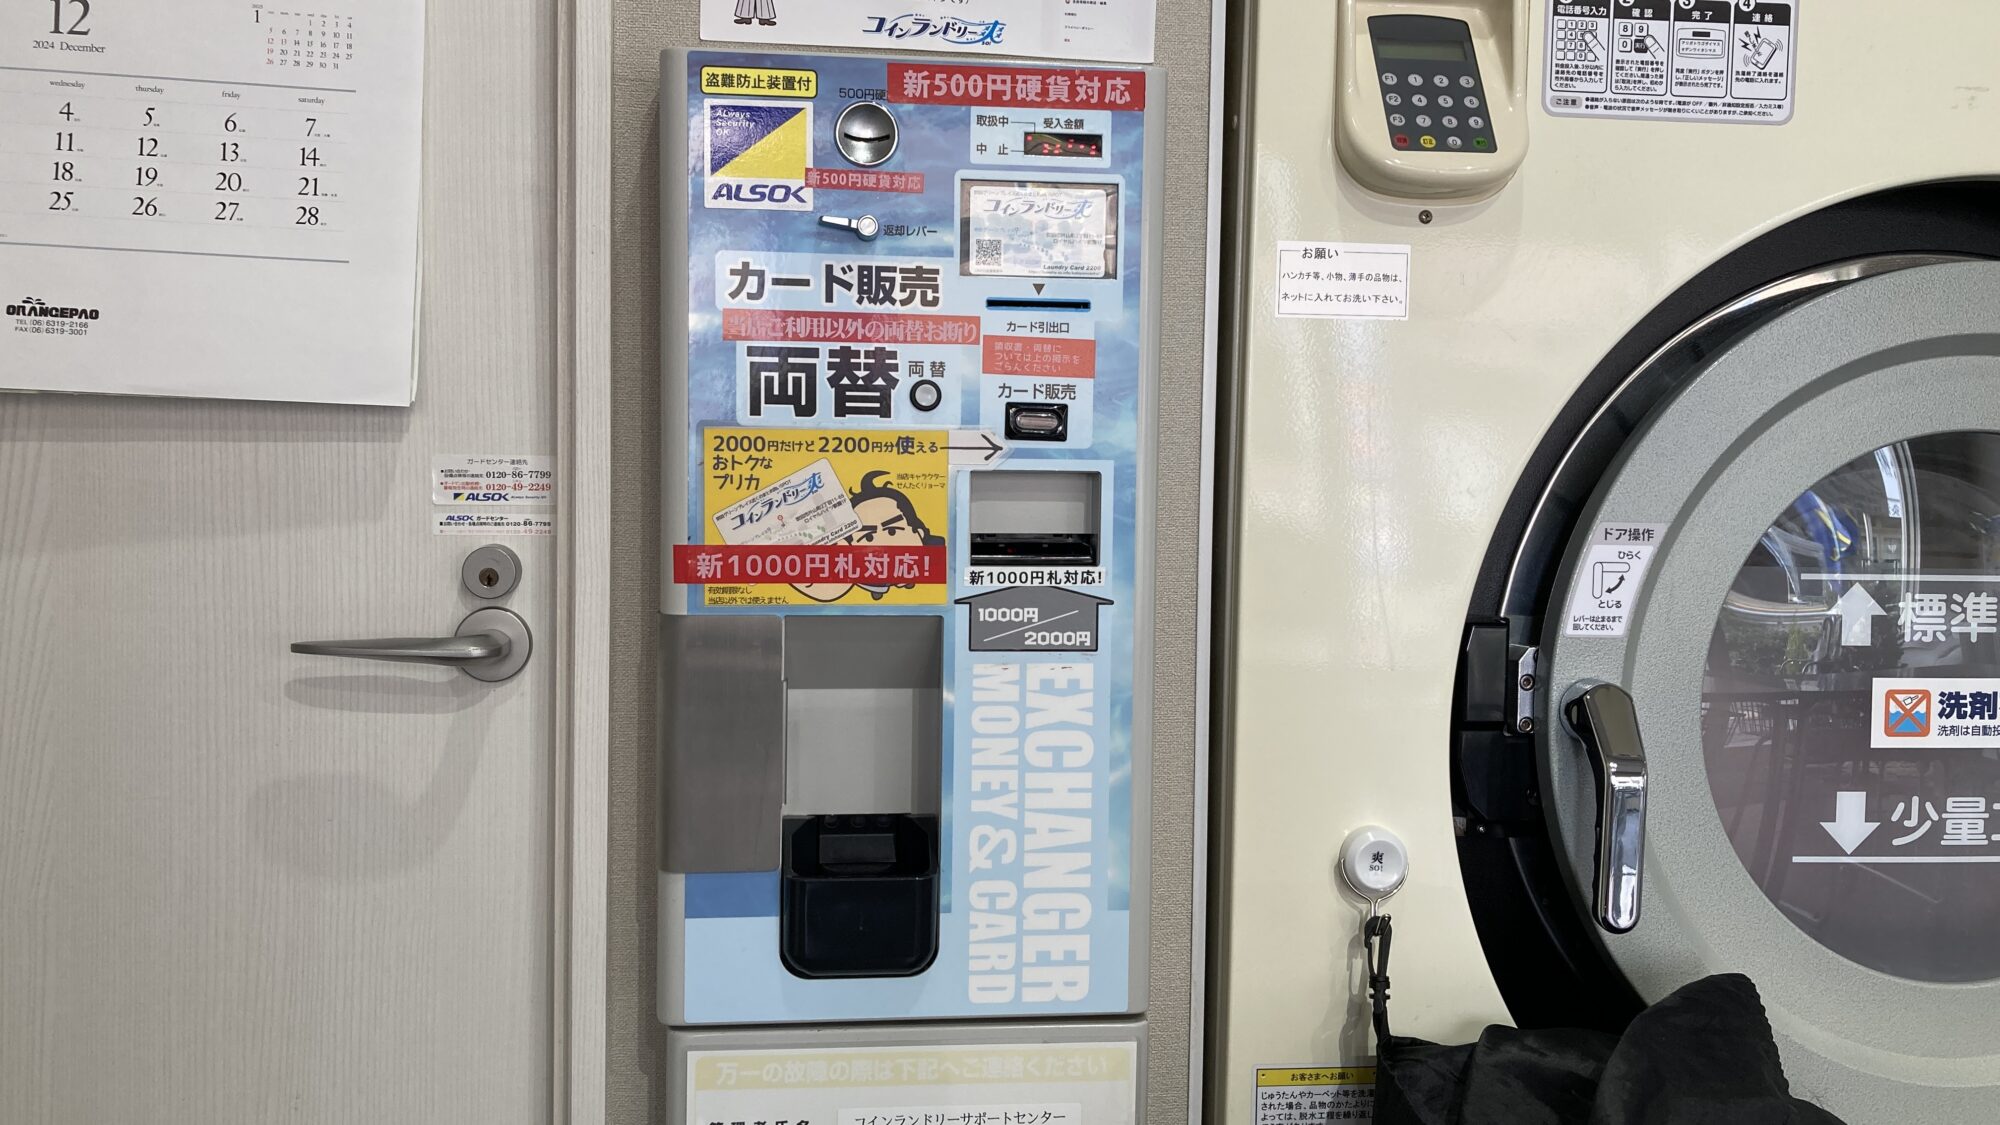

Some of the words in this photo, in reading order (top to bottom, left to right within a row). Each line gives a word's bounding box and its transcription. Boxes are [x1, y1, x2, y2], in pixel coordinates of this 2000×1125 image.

[255, 10, 260, 23] 1
[1557, 5, 1607, 16] 電話番号入力
[1632, 8, 1653, 17] 確認
[1691, 11, 1713, 20] 完了
[49, 0, 91, 35] 12
[1752, 13, 1773, 23] 連絡
[1638, 25, 1644, 33] 9
[33, 40, 55, 49] 2024
[60, 41, 106, 53] December
[1622, 40, 1627, 48] 0
[705, 72, 812, 91] 盗難防止装置付
[903, 69, 1131, 104] 新500円硬貨対応
[50, 80, 85, 90] wednesday
[135, 85, 164, 94] thursday
[222, 91, 240, 100] friday
[298, 97, 325, 105] saturday
[839, 87, 888, 100] 500円硬
[59, 101, 74, 121] 4
[143, 107, 155, 127] 5
[224, 112, 237, 132] 6
[306, 118, 317, 137] 7
[715, 119, 755, 128] Security
[976, 115, 1009, 127] 取扱中
[1043, 118, 1085, 130] 受入金額
[56, 132, 74, 151] 11
[138, 137, 159, 157] 12
[220, 142, 239, 162] 13
[300, 147, 320, 167] 14
[53, 161, 74, 181] 18
[135, 166, 158, 186] 19
[215, 172, 242, 191] 20
[298, 177, 319, 196] 21
[808, 168, 921, 190] 新500円硬貨対応
[712, 183, 807, 203] ALSOK
[49, 191, 74, 210] 25
[132, 196, 158, 217] 26
[214, 201, 240, 221] 27
[295, 206, 319, 226] 28
[883, 224, 938, 237] 返却レバー
[1302, 247, 1339, 259] お願い
[1043, 264, 1068, 272] Laundry
[1282, 271, 1403, 283] ハンカチ等、小物、薄手の品物は、
[728, 261, 940, 307] カード販売
[1281, 292, 1403, 304] ネットに入れてお洗い下さい。
[46, 320, 88, 328] 6319-2166
[727, 315, 977, 343] 当店ご利用以外の両替お断り
[1007, 321, 1070, 333] カード引出口
[45, 327, 87, 335] 6319-3001
[994, 362, 1061, 373] ごらんください
[746, 345, 900, 419] 両替
[998, 383, 1077, 400] カード販売
[712, 454, 773, 471] おトクな
[485, 470, 552, 479] 0120-86-7799
[485, 482, 551, 491] 0120-49-2249
[713, 474, 760, 491] プリカ
[465, 493, 509, 501] ALSOK
[830, 526, 844, 537] Card
[1604, 528, 1655, 541] ドア操作
[1618, 551, 1641, 560] ひらく
[696, 552, 930, 580] 新1000円札対応!
[969, 570, 1102, 585] 新1000円札対応!
[708, 596, 789, 605] 当店以外では使えません
[1598, 600, 1622, 608] とじる
[978, 607, 1038, 622] 1000円
[1573, 615, 1623, 623] レバーは止まるまで
[1898, 592, 1998, 642] 標準
[1572, 623, 1614, 631] 回してください。
[1024, 631, 1091, 646] 2000円
[970, 662, 1021, 821] MONEY
[1891, 795, 2000, 846] 少量
[1022, 662, 1095, 1003] EXCHANGER
[969, 824, 1018, 874] &
[1371, 851, 1384, 864] 爽
[968, 880, 1018, 1004] CARD
[716, 1056, 1108, 1086] 万一の故障の際は下記へご連絡ください
[1291, 1071, 1354, 1081] お客さまへお願い
